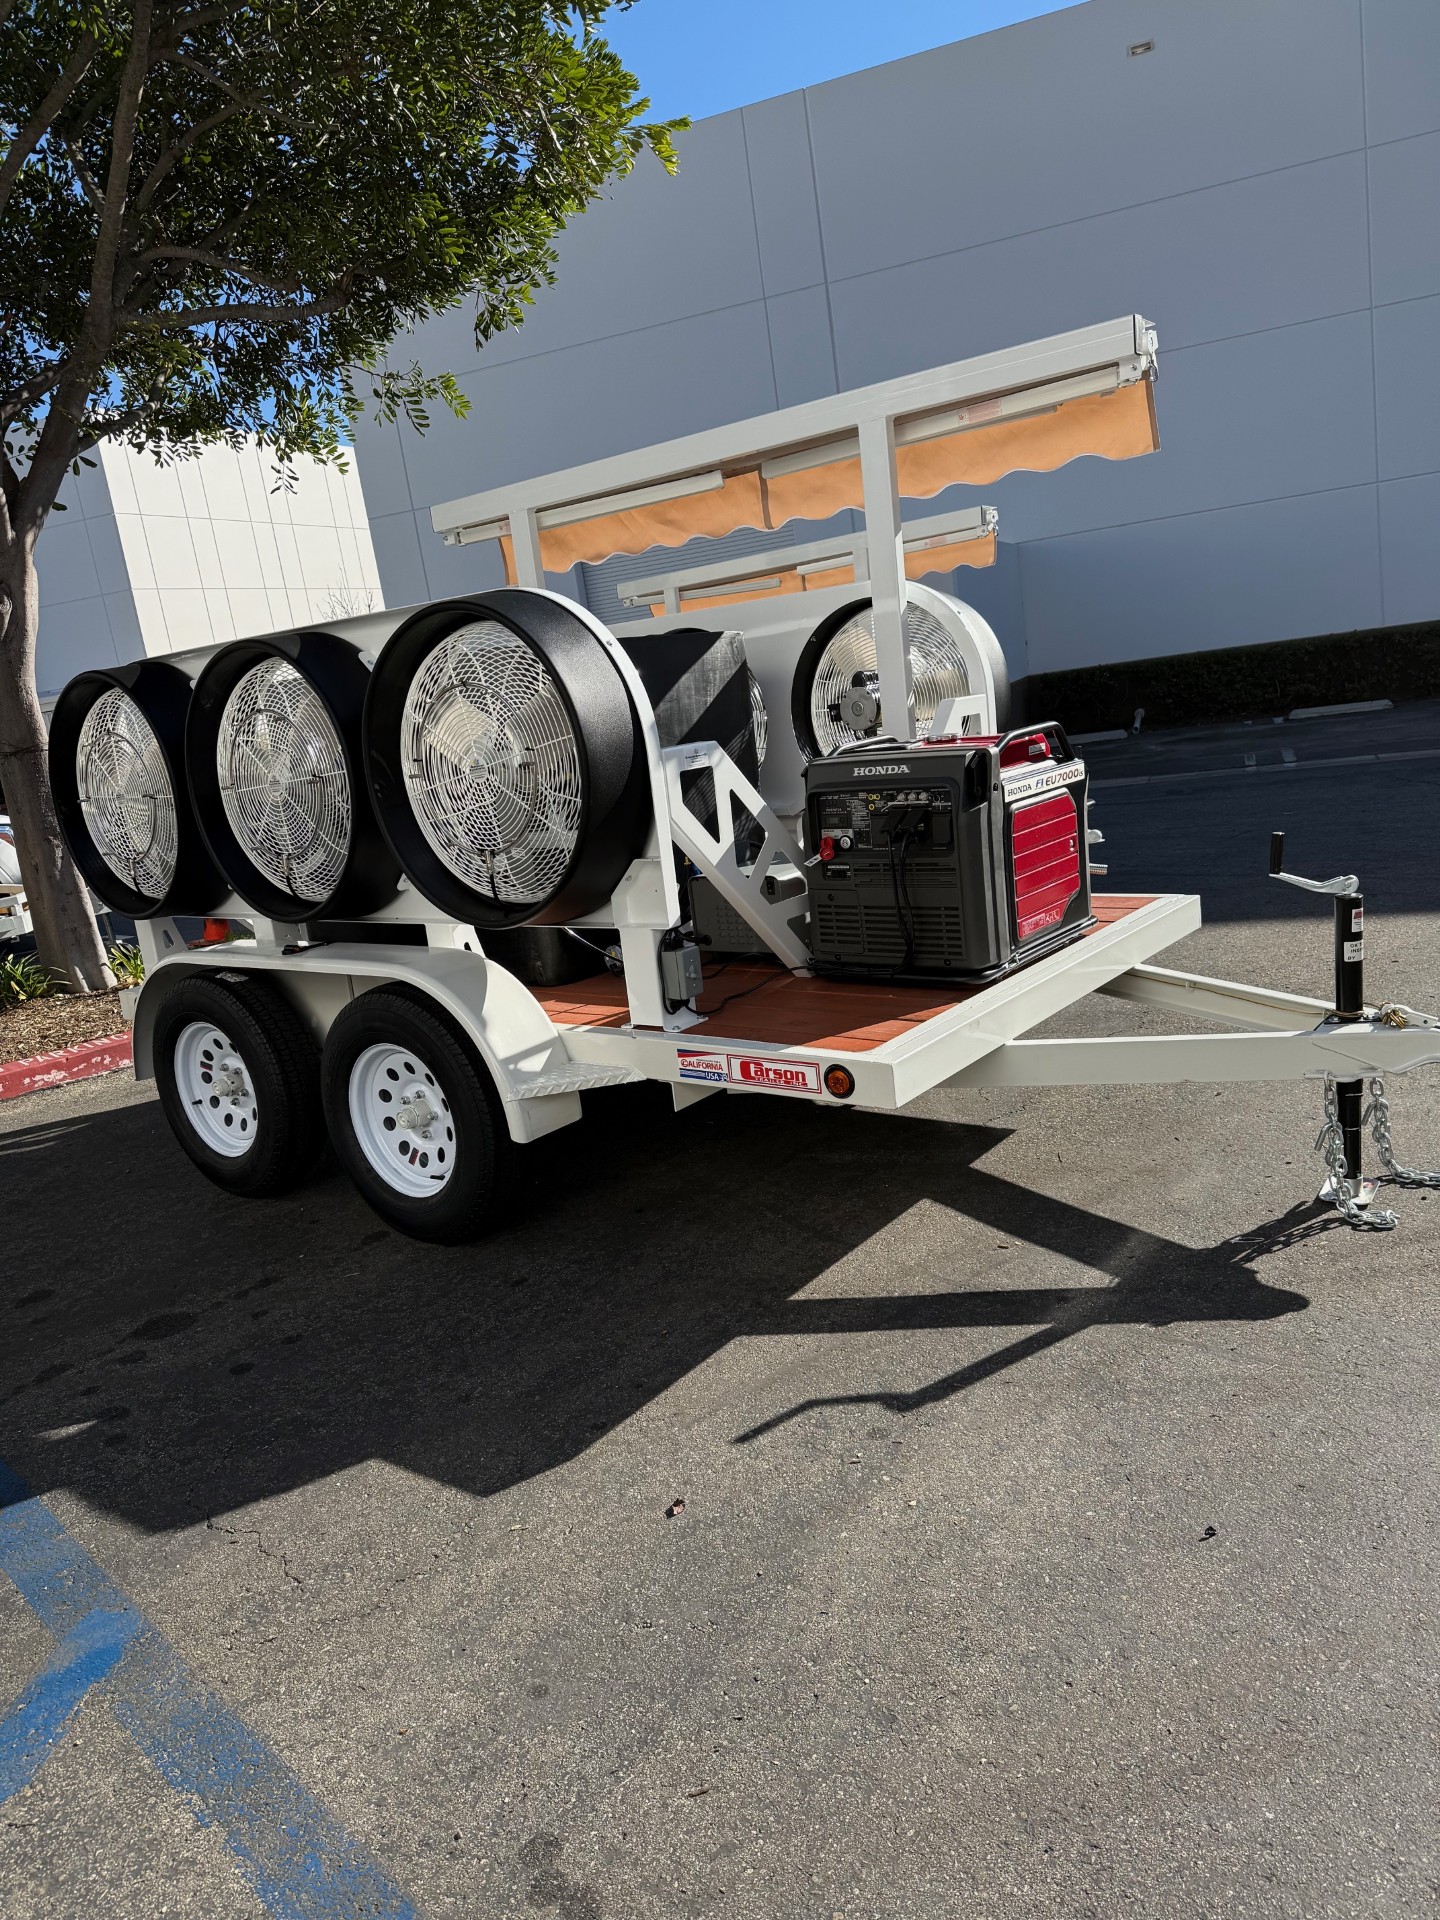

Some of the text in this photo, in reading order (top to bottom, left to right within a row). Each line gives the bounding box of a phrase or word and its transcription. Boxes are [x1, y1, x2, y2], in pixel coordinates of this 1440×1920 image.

[853, 764, 910, 777] HONDA
[1007, 783, 1032, 797] HONDA
[18, 1033, 129, 1066] PARKING
[681, 1058, 724, 1071] CALIFORNIA
[705, 1072, 720, 1081] USA
[739, 1060, 807, 1083] Carson
